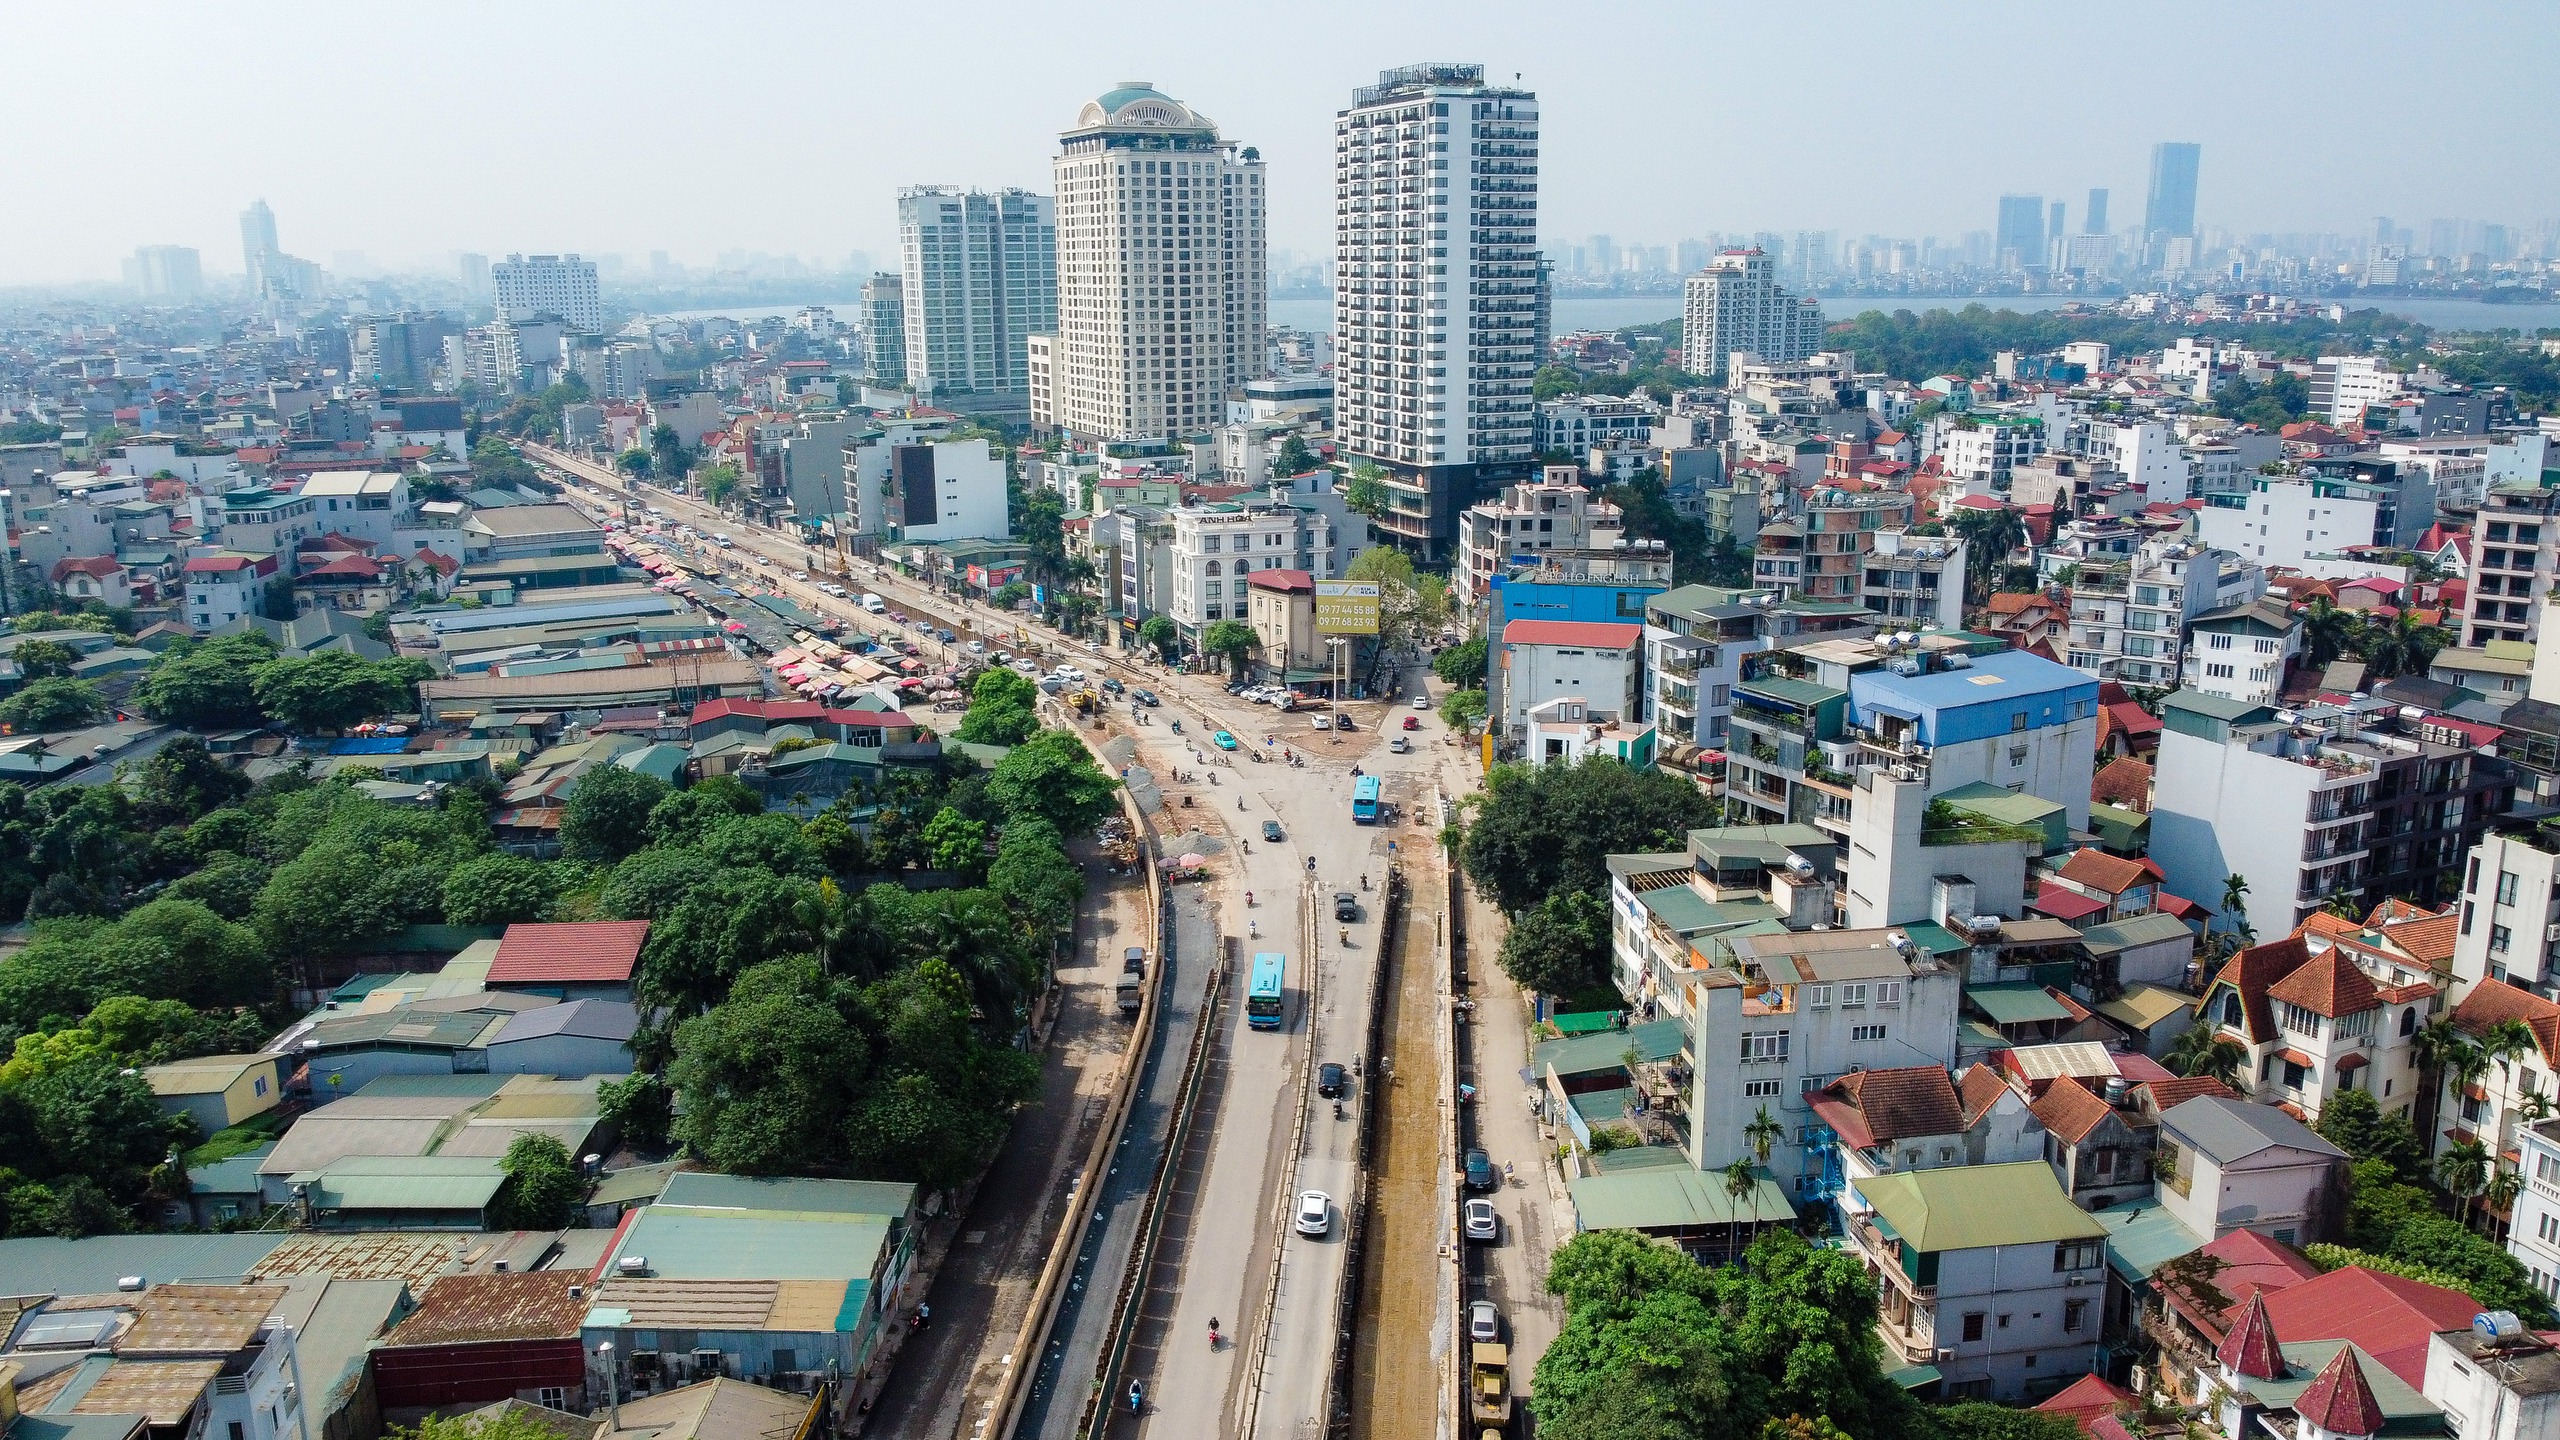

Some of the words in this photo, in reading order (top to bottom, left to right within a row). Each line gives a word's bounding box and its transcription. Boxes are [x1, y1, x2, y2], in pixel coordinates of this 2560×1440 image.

[1199, 516, 1225, 524] ANH
[1587, 573, 1640, 585] ENGLISH
[1319, 605, 1330, 614] 09
[1330, 605, 1341, 614] 77
[1342, 605, 1352, 615] 44
[1353, 606, 1364, 615] 55
[1365, 606, 1375, 615] 88
[1319, 617, 1330, 626] 09
[1330, 617, 1341, 626] 77
[1342, 617, 1352, 626] 68
[1353, 618, 1364, 627] 23
[1365, 618, 1375, 627] 93
